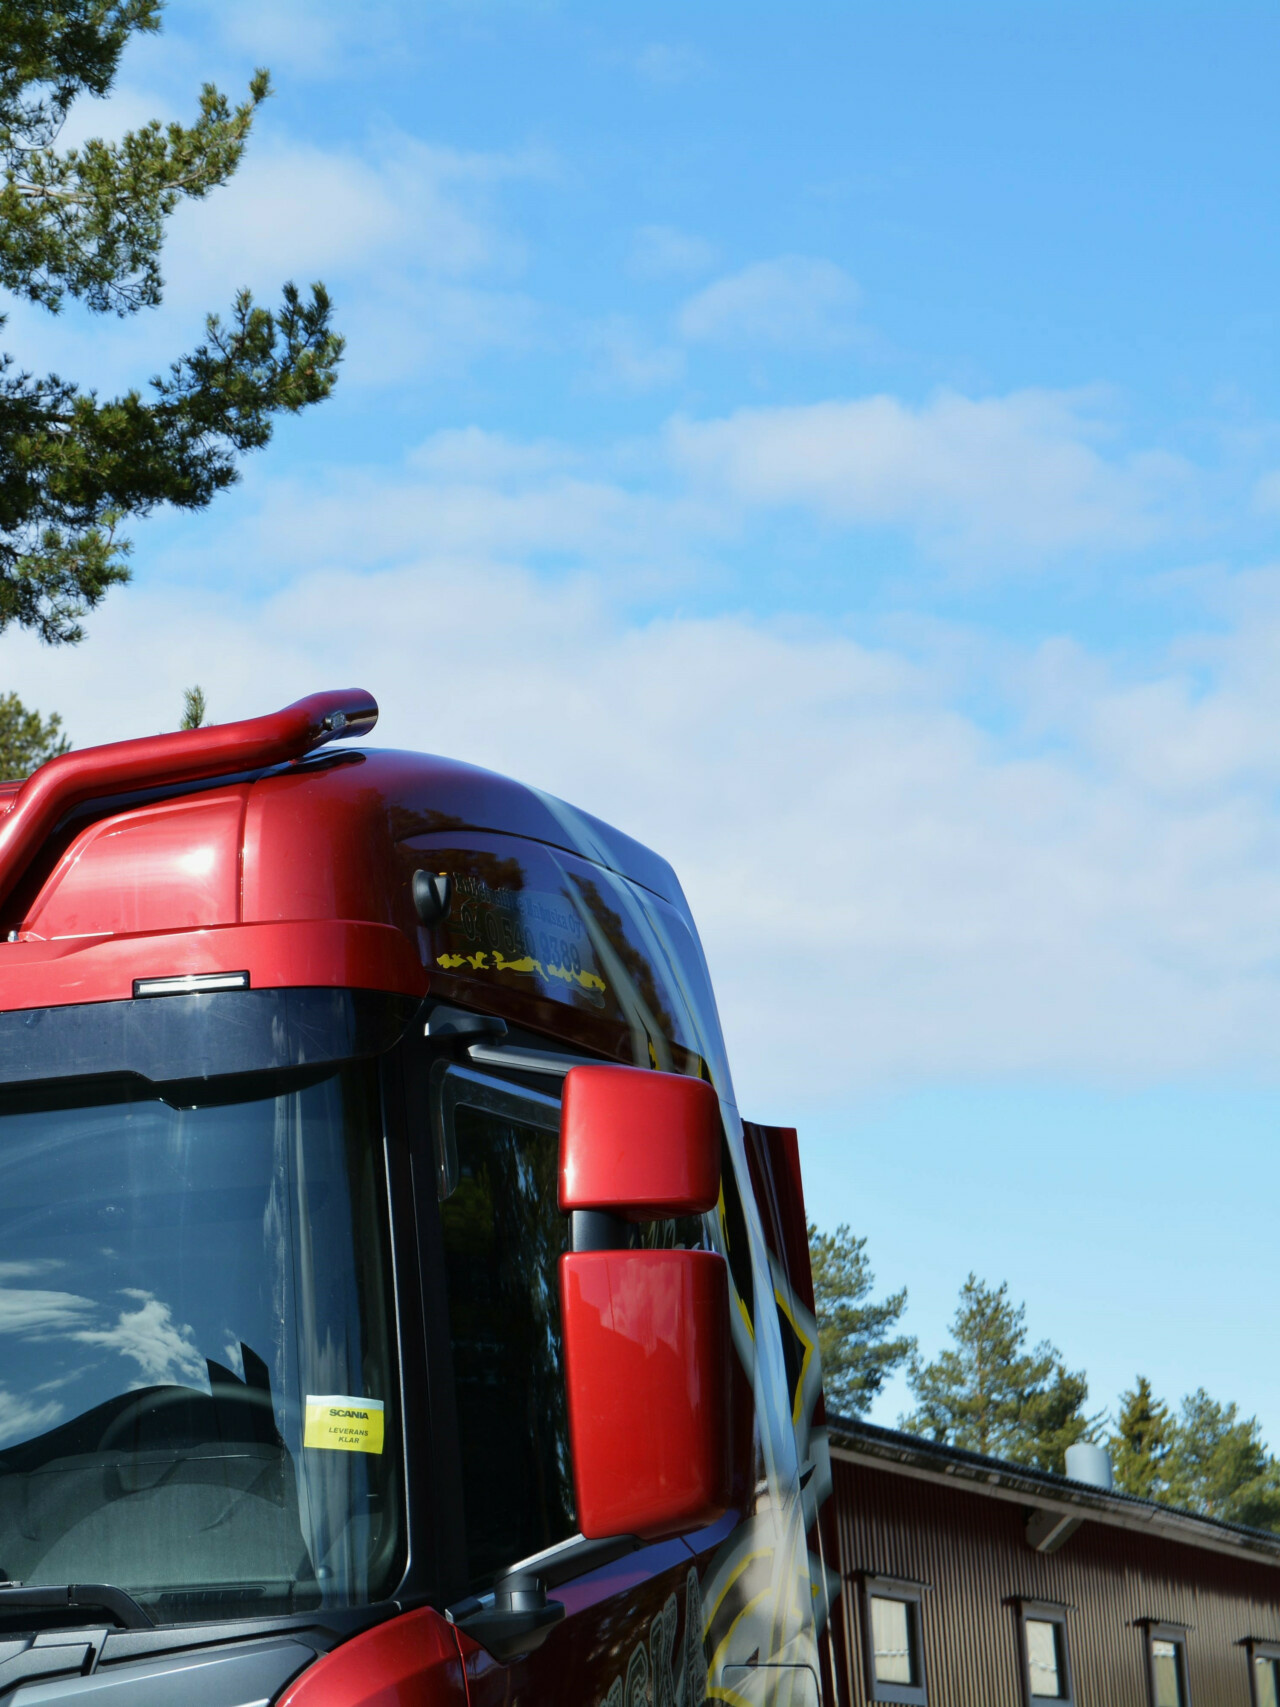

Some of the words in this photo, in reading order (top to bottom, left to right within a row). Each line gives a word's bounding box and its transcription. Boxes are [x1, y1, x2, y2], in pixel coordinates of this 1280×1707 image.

[329, 1408, 369, 1420] SCANIA
[328, 1426, 369, 1437] LEVERANS
[338, 1436, 360, 1444] KLAR
